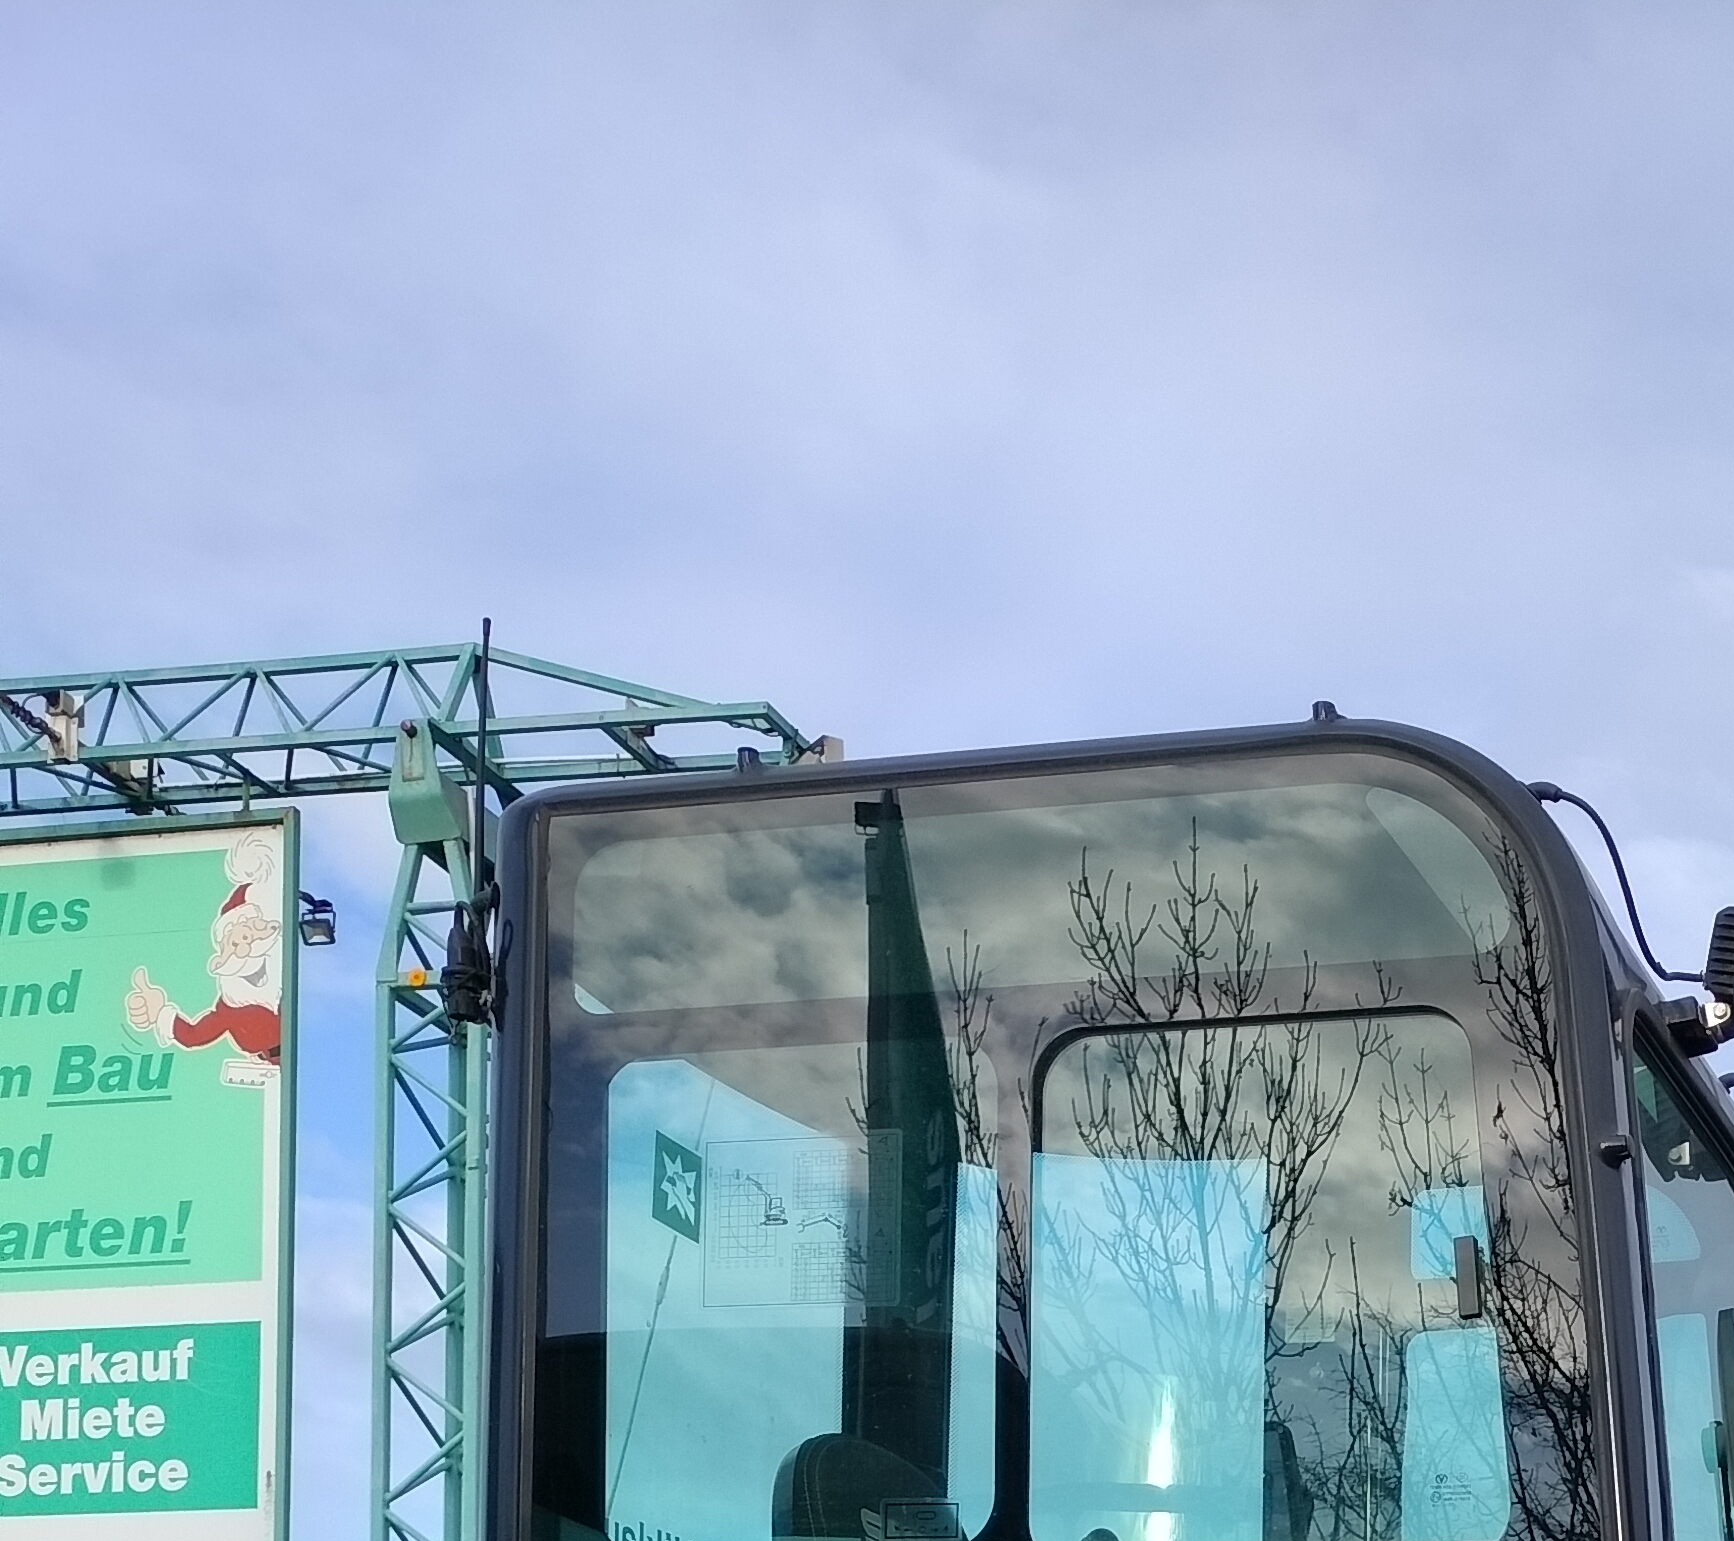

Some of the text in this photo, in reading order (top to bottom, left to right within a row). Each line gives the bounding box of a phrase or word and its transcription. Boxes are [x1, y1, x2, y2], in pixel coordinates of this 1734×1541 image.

[0, 969, 82, 1017] nd
[53, 1045, 174, 1096] Bau
[0, 1338, 194, 1387] Verkauf
[20, 1397, 166, 1441] Miete
[0, 1450, 189, 1497] Service
